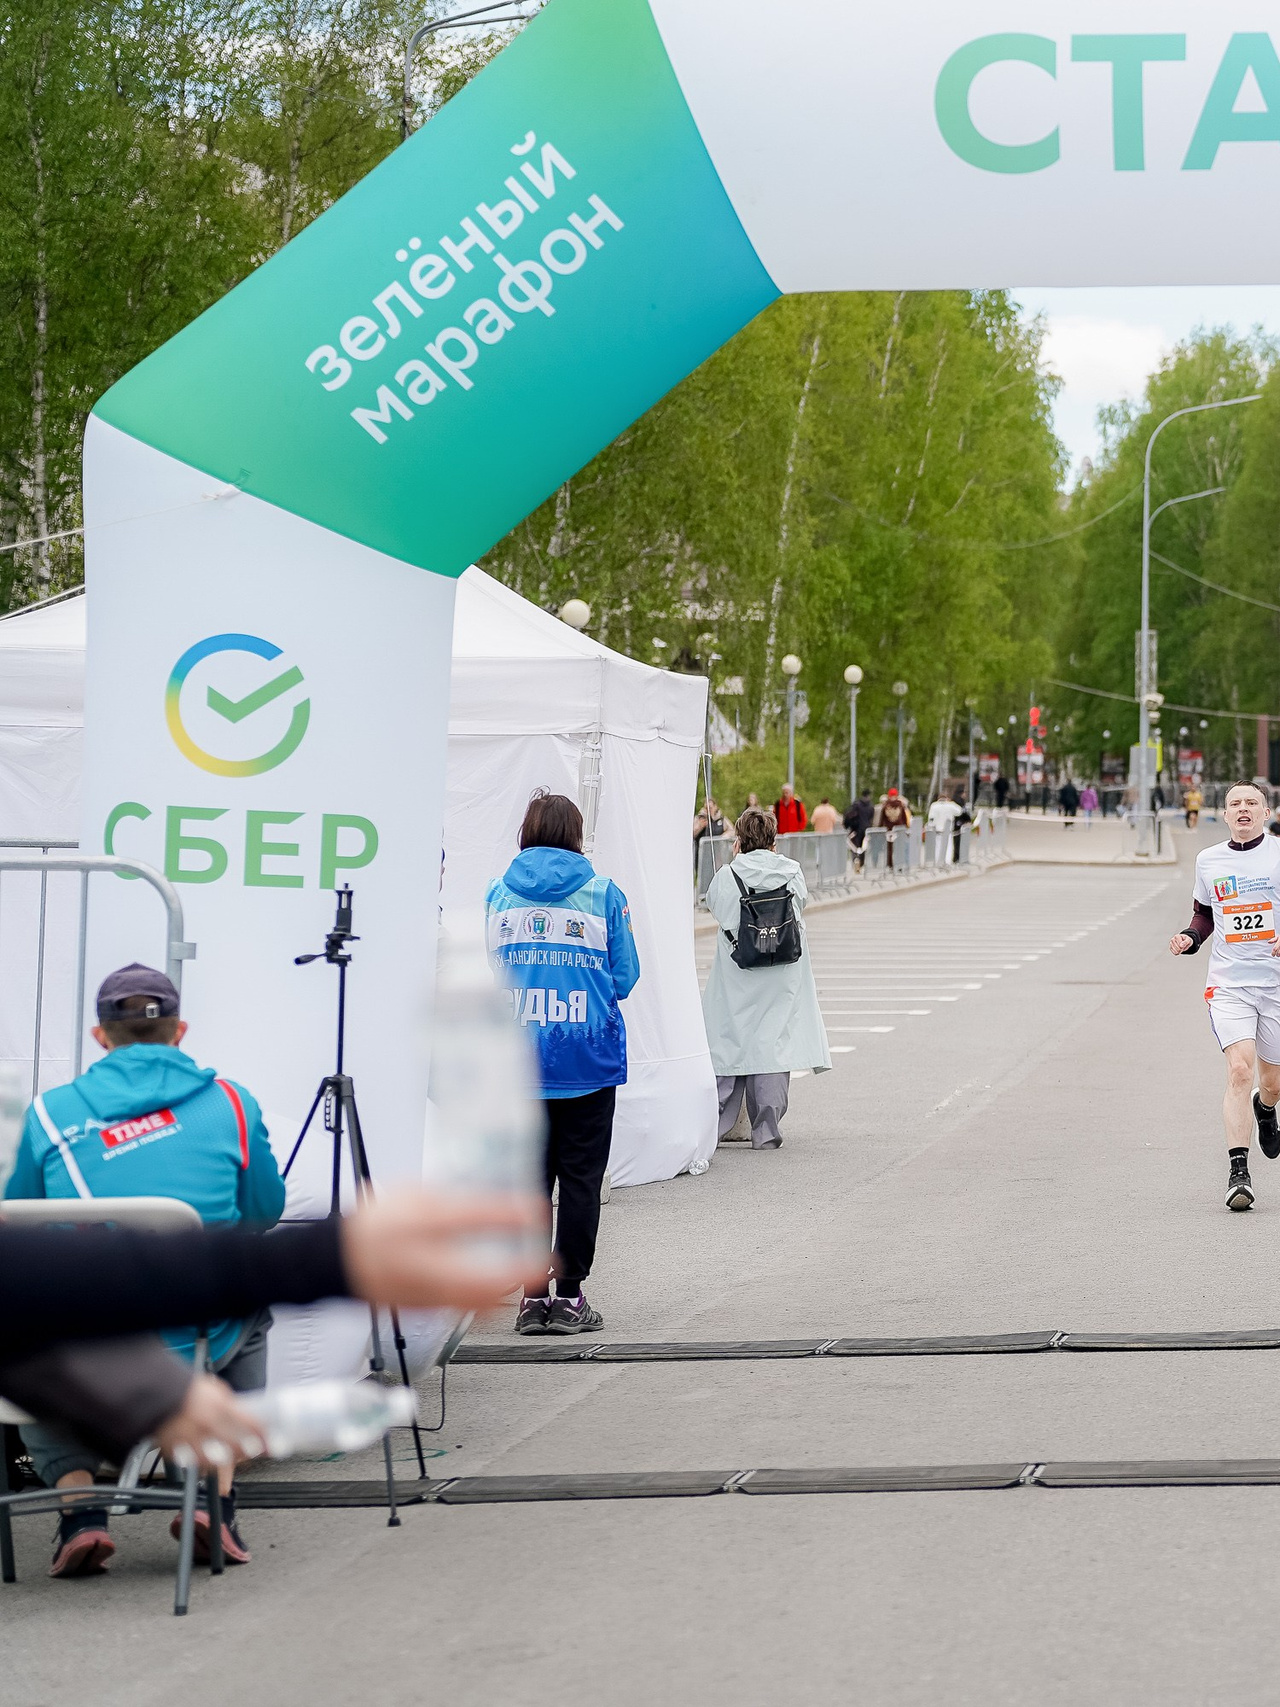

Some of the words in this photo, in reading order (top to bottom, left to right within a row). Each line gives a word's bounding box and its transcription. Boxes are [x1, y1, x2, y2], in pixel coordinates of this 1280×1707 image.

[304, 130, 577, 392] зелёный
[350, 193, 624, 445] марафон
[104, 801, 379, 890] СБЕР
[1233, 914, 1265, 930] 322
[549, 950, 573, 967] ЮГРА
[503, 987, 588, 1028] УДЬЯ
[108, 1113, 167, 1142] TIME
